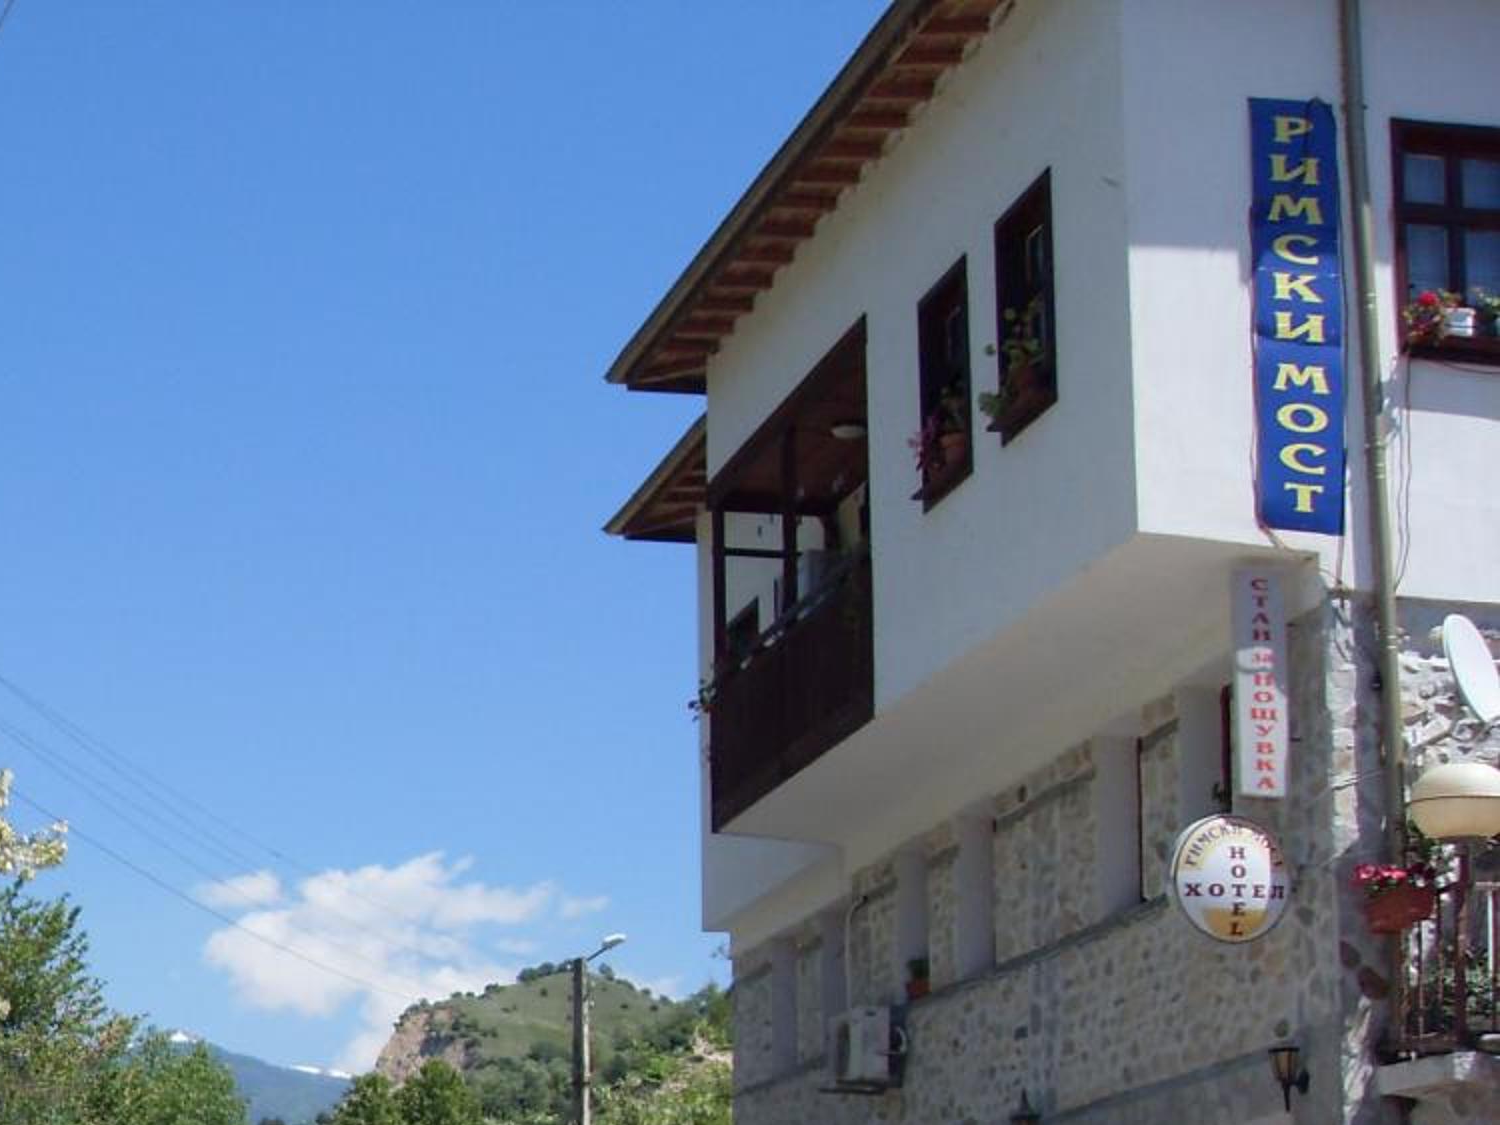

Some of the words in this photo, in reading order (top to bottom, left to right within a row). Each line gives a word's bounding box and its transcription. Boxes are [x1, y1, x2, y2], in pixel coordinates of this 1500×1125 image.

[1267, 115, 1326, 343] РИМСКИ
[1273, 363, 1331, 512] МОСТ
[1250, 577, 1272, 641] СТАИ
[1185, 883, 1284, 899] ХОТЕЛ
[1230, 845, 1247, 936] HOTEL
